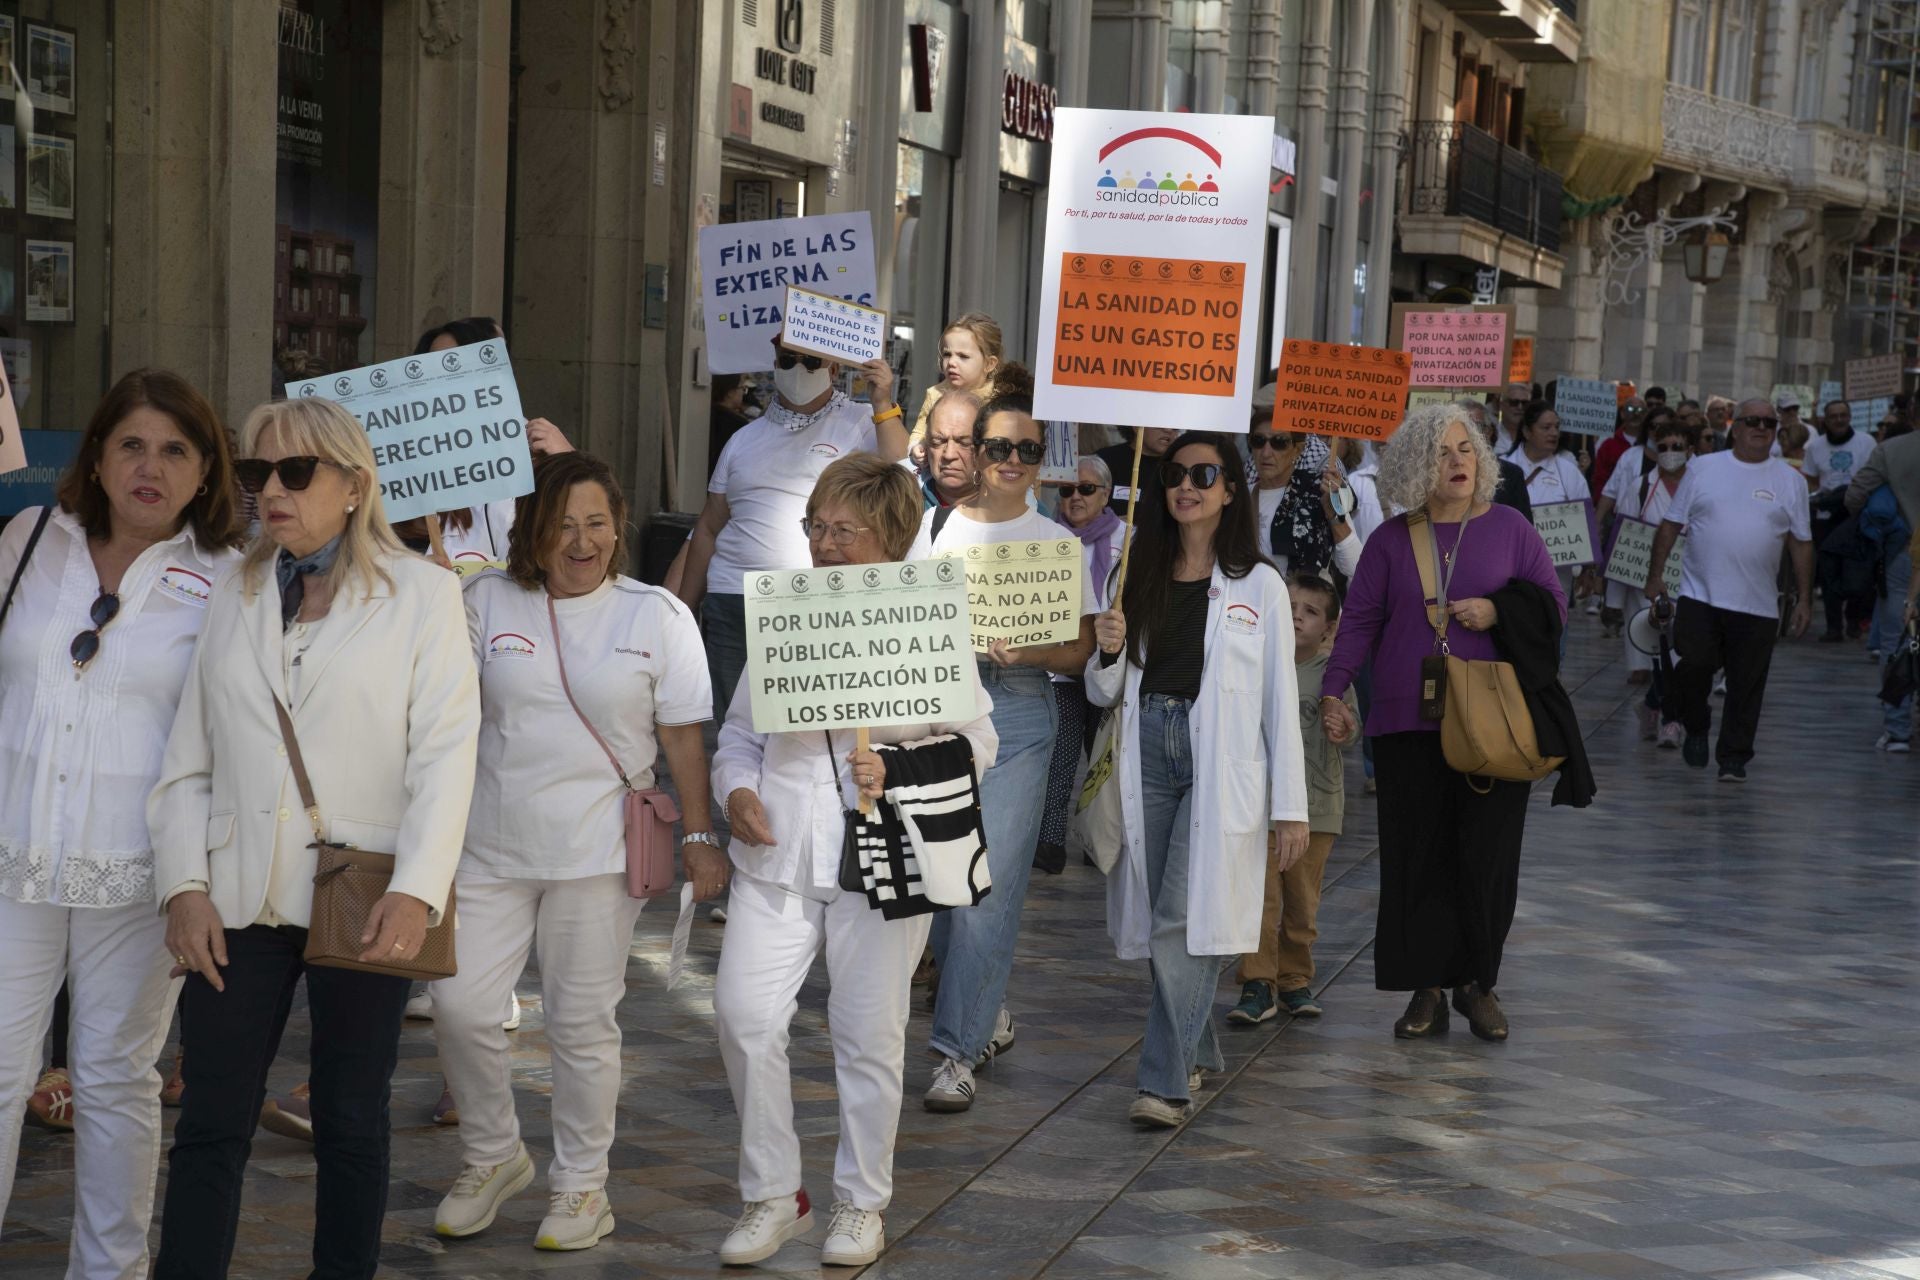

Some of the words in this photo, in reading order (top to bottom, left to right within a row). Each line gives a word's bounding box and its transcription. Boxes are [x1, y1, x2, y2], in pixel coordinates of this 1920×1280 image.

[278, 6, 325, 56] ERRA
[298, 100, 323, 121] VENTA
[276, 122, 287, 137] EVA
[1096, 188, 1219, 207] sanidadpública
[1065, 208, 1080, 217] Por
[1091, 211, 1107, 220] por
[1108, 211, 1118, 219] tu
[1119, 211, 1145, 222] salud,
[1147, 214, 1164, 223] por
[1165, 213, 1174, 222] la
[1175, 213, 1187, 222] de
[1188, 215, 1213, 224] todas
[1222, 216, 1248, 226] todos
[772, 239, 796, 258] DE
[806, 229, 856, 256] LAS
[1063, 291, 1090, 310] LA
[1096, 293, 1196, 316] SANIDAD
[1204, 300, 1239, 319] NO
[795, 305, 808, 316] LA
[811, 310, 861, 330] SANIDAD
[864, 325, 876, 335] ES
[788, 316, 805, 327] UN
[808, 321, 860, 342] DERECHO
[863, 337, 880, 348] NO
[1060, 323, 1084, 341] ES
[1091, 325, 1124, 344] UN
[1131, 327, 1204, 350] GASTO
[1212, 332, 1236, 351] ES
[1409, 332, 1429, 341] POR
[1431, 332, 1454, 341] UNA
[1456, 333, 1500, 342] SANIDAD
[792, 329, 809, 341] UN
[812, 335, 874, 359] PRIVILEGIO
[1457, 347, 1472, 356] NO
[1474, 347, 1481, 355] A
[1484, 347, 1496, 356] LA
[1057, 354, 1106, 375] UNA
[1112, 359, 1234, 383] INVERSIÓN
[1285, 363, 1311, 376] POR
[1314, 367, 1342, 379] UNA
[1345, 370, 1403, 386] SANIDAD
[1484, 361, 1497, 369] DE
[1416, 374, 1434, 383] LOS
[1437, 374, 1486, 383] SERVICIOS
[1286, 379, 1342, 397] PÚBLICA.
[1346, 388, 1367, 399] NO
[1369, 391, 1378, 401] A
[1381, 391, 1397, 404] LA
[1557, 391, 1566, 399] LA
[1567, 393, 1601, 405] SANIDAD
[1603, 399, 1616, 407] NO
[354, 393, 466, 432] ANIDAD
[474, 385, 503, 409] ES
[1282, 398, 1378, 419] PRIVATIZACIÓN
[1380, 409, 1398, 421] DE
[1566, 405, 1577, 415] UN
[1581, 407, 1605, 418] GASTO
[1291, 416, 1315, 429] LOS
[1318, 419, 1382, 437] SERVICIOS
[373, 428, 473, 467] ERECHO
[481, 418, 521, 444] NO
[1545, 536, 1565, 547] CA:
[1567, 533, 1583, 545] LA
[1618, 535, 1631, 547] LA
[1549, 550, 1577, 562] TRA
[1613, 549, 1626, 560] ES
[1627, 553, 1643, 566] UN
[965, 573, 989, 586] NA
[994, 568, 1073, 586] SANIDAD
[1608, 563, 1631, 577] UNA
[967, 592, 993, 607] CA.
[998, 592, 1025, 607] NO
[1030, 592, 1043, 605] A
[1047, 590, 1069, 603] LA
[758, 614, 802, 633] POR
[808, 610, 856, 629] UNA
[861, 603, 958, 626] SANIDAD
[1049, 609, 1071, 623] DE
[765, 641, 862, 664] PÚBLICA.
[868, 638, 901, 657] NO
[907, 636, 923, 654] A
[929, 634, 955, 652] LA
[763, 664, 927, 695] PRIVATIZACIÓN
[935, 665, 961, 683] DE
[787, 705, 827, 724] LOS
[833, 697, 942, 721] SERVICIOS
